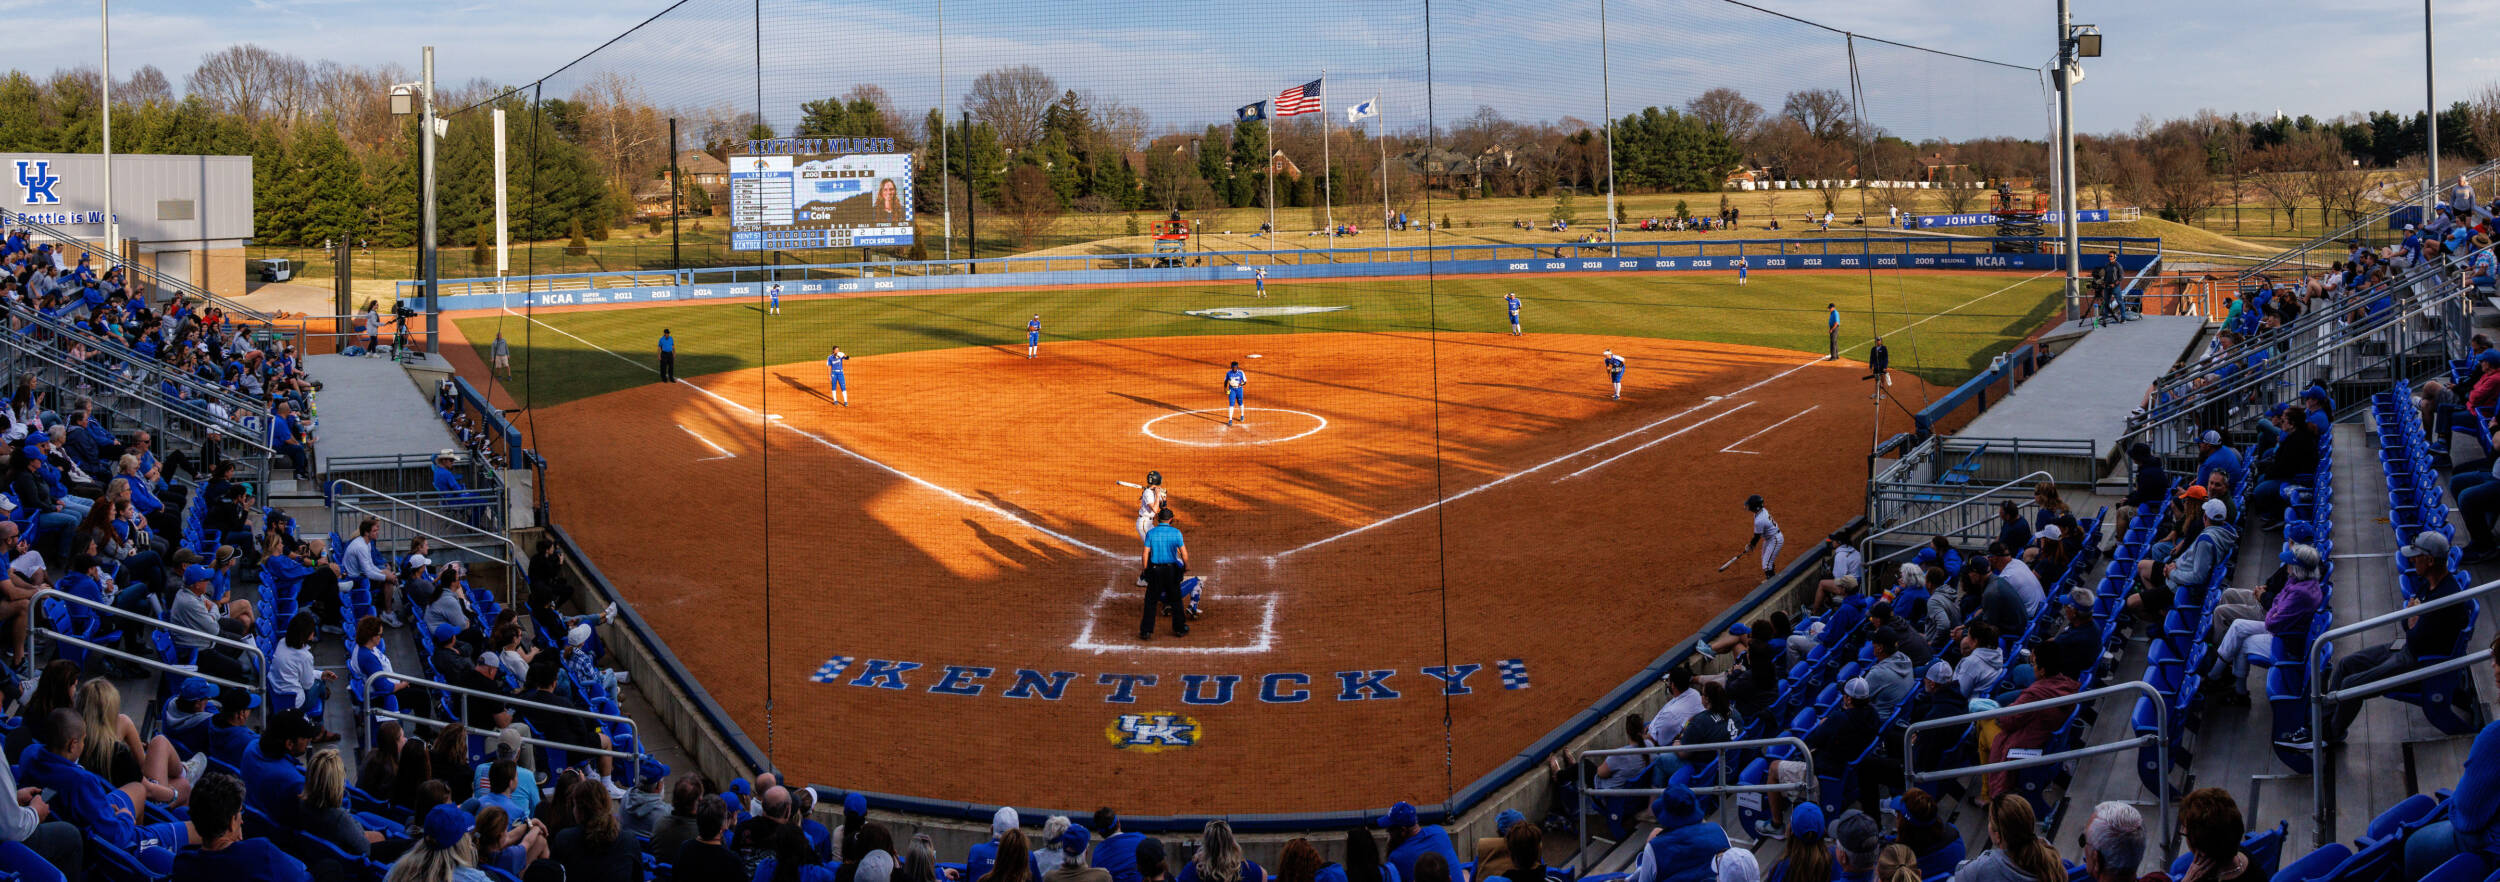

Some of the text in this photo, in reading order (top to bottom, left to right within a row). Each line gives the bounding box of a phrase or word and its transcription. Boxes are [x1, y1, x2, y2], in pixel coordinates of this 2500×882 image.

[748, 137, 895, 155] KENTUCKY WILDCATS
[14, 160, 61, 205] UK
[17, 211, 66, 225] Battle
[70, 211, 84, 225] is
[811, 211, 831, 220] Cole
[1944, 217, 1976, 225] JOHN
[736, 232, 752, 240] KENT
[1582, 261, 1602, 269] 2018
[1915, 257, 1934, 265] 2009
[1976, 256, 2006, 266] NCAA
[651, 290, 670, 298] 2013
[693, 288, 712, 296] 2014
[729, 286, 749, 295] 2015
[802, 283, 822, 291] 2018
[838, 282, 858, 290] 2019
[874, 281, 894, 289] 2021
[542, 293, 573, 304] NCAA
[848, 658, 1482, 705] KENTUCKY
[1117, 714, 1195, 746] UK
